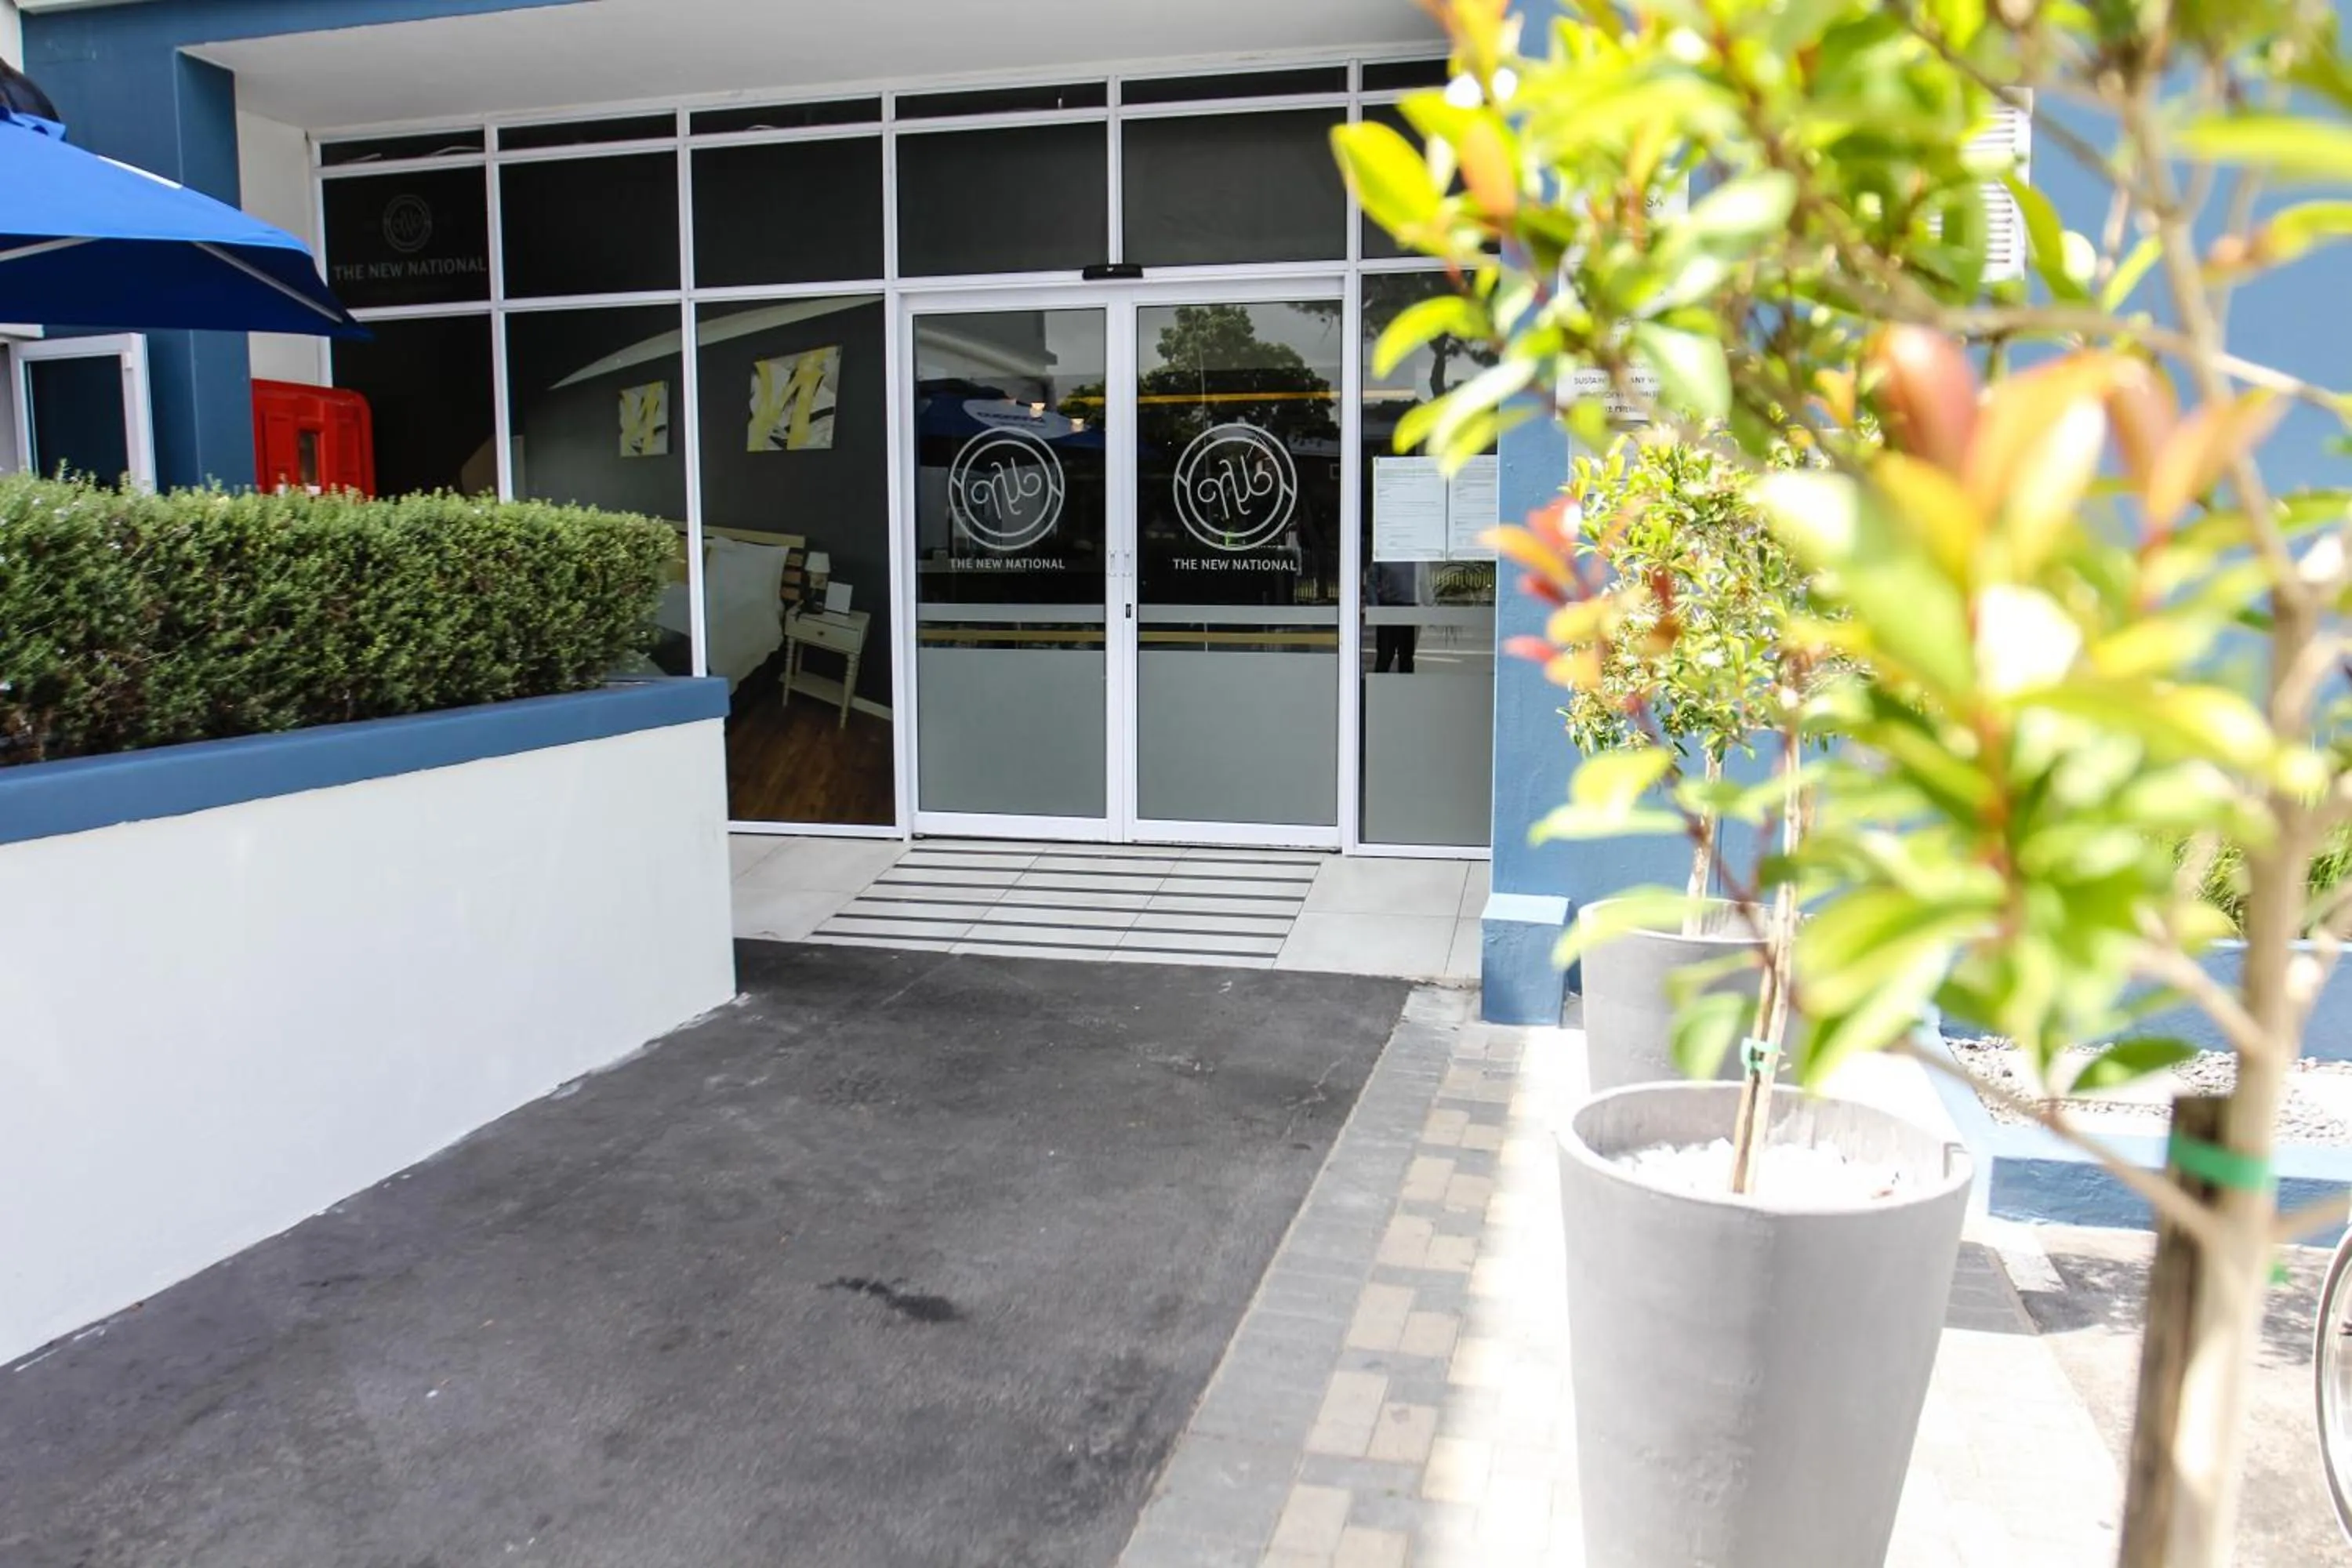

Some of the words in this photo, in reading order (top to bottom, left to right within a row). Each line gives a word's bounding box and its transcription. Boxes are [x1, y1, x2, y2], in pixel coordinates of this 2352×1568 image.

[332, 264, 364, 280] THE
[368, 261, 404, 278] NEW
[407, 256, 487, 276] NATIONAL
[950, 558, 973, 568] THE
[976, 558, 1002, 568] NEW
[1006, 558, 1065, 569] NATIONAL
[1173, 559, 1197, 570] THE
[1202, 559, 1229, 570] NEW
[1232, 559, 1298, 571] NATIONAL
